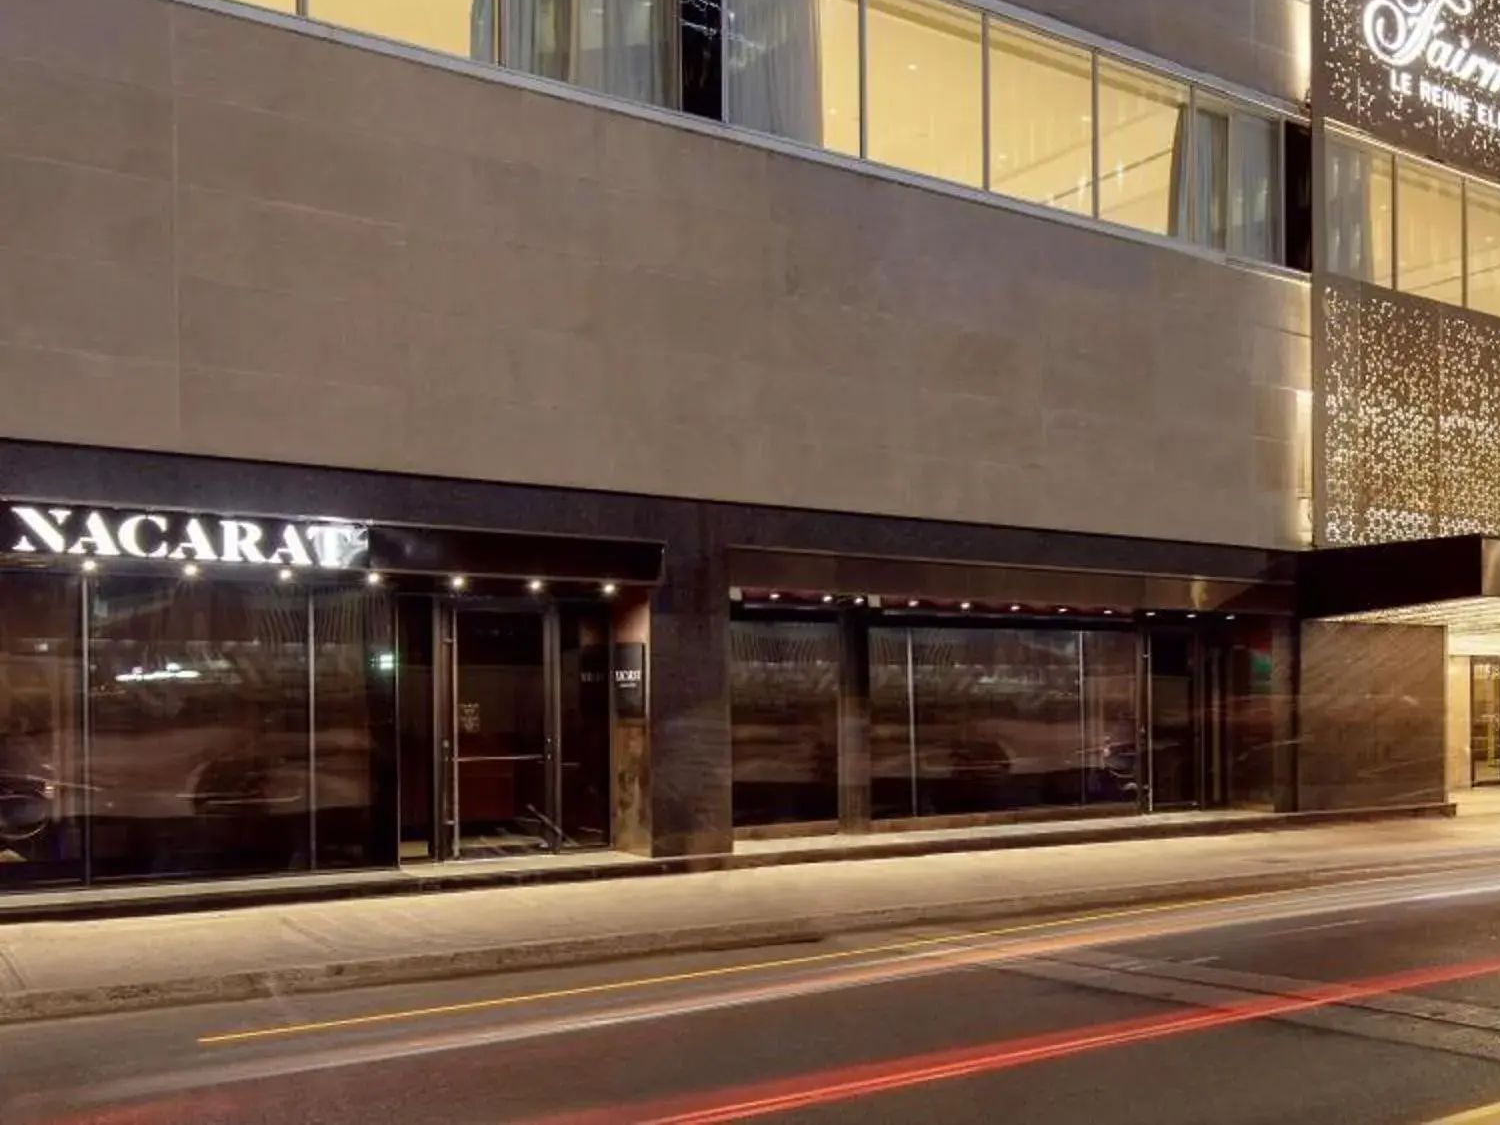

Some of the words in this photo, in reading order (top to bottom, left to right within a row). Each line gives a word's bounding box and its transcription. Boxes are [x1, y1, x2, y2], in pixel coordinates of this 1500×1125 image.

[1389, 69, 1413, 96] LE
[1419, 79, 1472, 117] REINE
[11, 506, 352, 568] NACARAT
